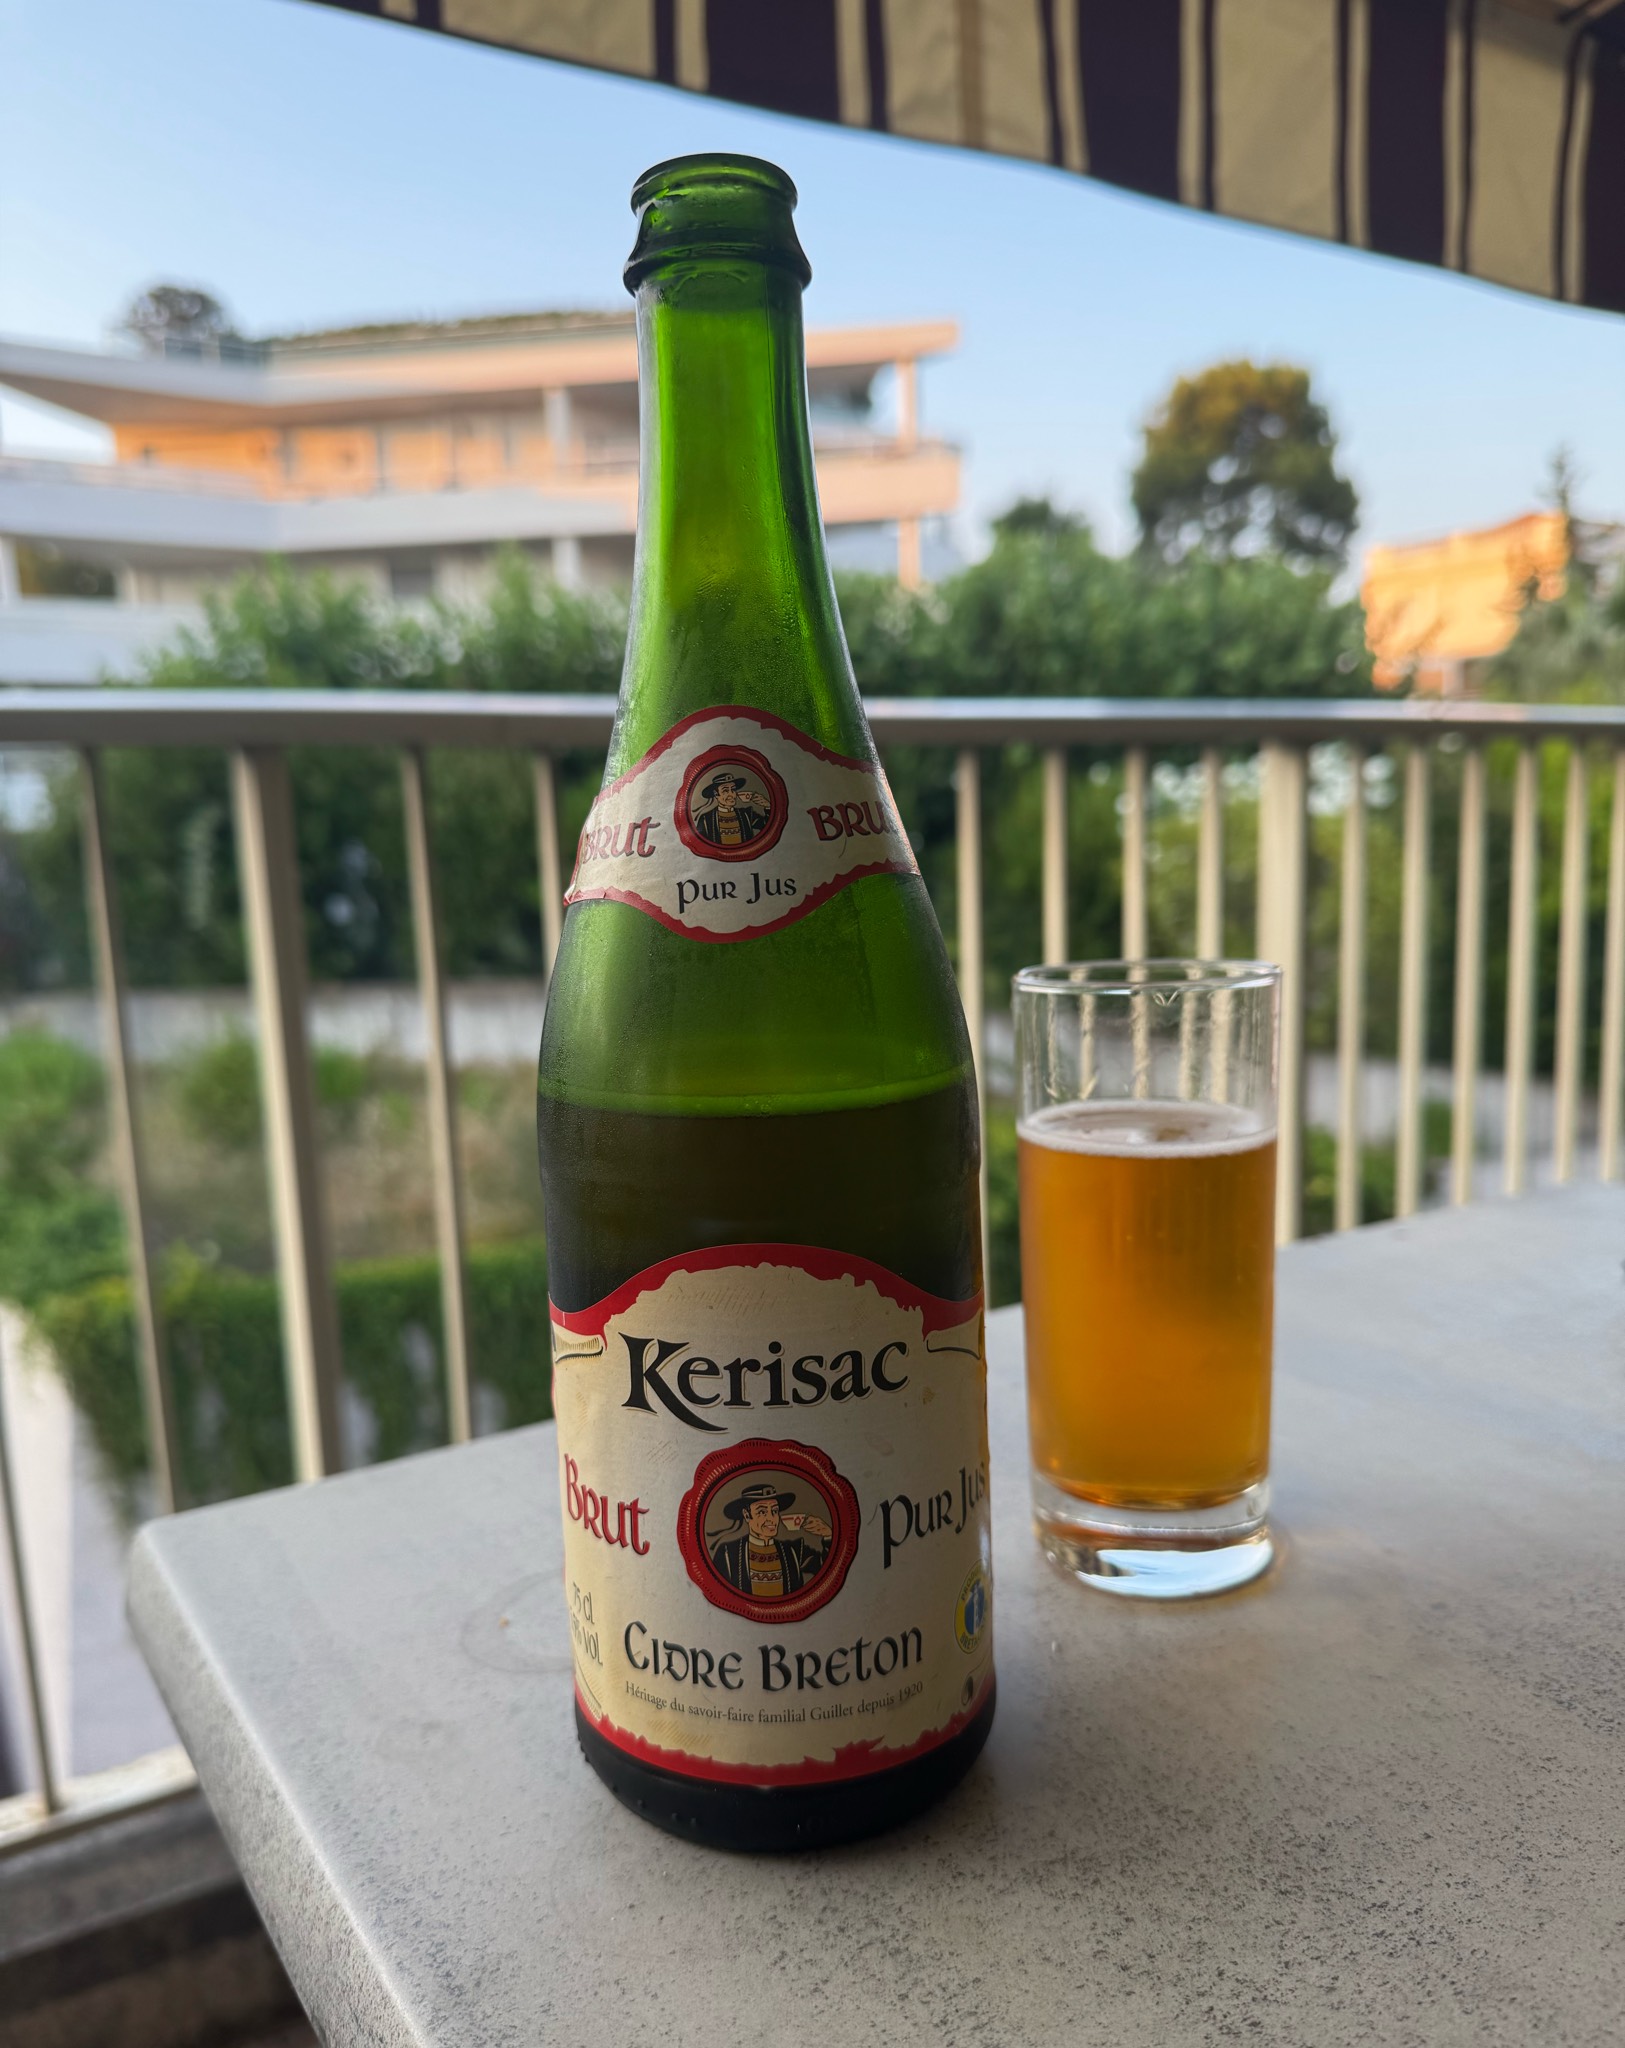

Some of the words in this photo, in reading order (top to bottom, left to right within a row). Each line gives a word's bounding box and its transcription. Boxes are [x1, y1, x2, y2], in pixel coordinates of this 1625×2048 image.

[806, 801, 892, 841] BRU
[746, 872, 797, 904] Jus
[618, 1332, 908, 1431] Kerisac
[625, 1680, 668, 1710] Héritage
[670, 1697, 685, 1712] du
[688, 1705, 755, 1723] savoir-faire
[758, 1708, 806, 1723] familial
[810, 1703, 853, 1721] Guillet
[857, 1692, 895, 1715] depuis
[899, 1680, 924, 1705] 1920
